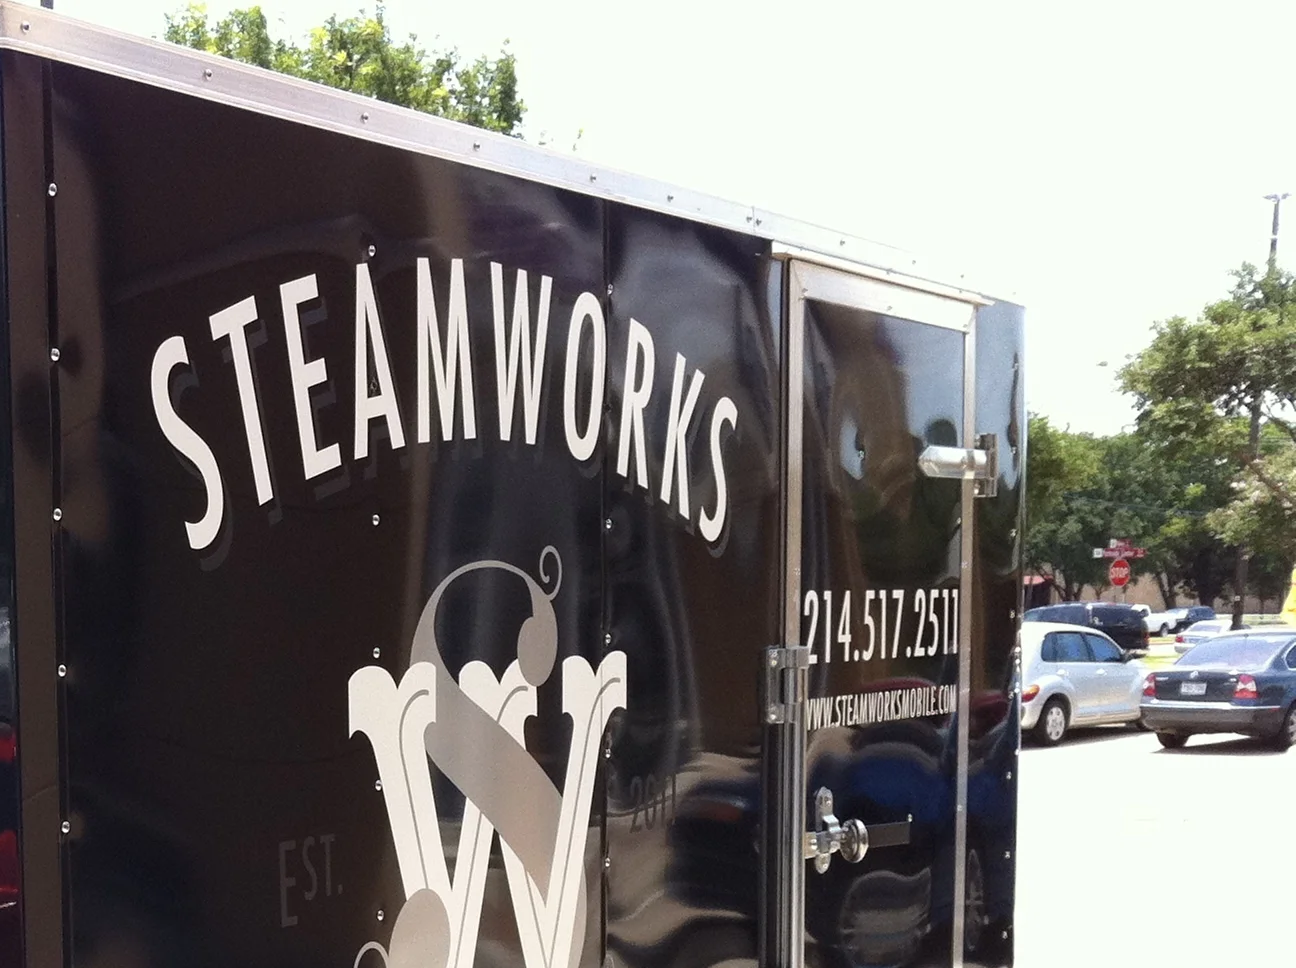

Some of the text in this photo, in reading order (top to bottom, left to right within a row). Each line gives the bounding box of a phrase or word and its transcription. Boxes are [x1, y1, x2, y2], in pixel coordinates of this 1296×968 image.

[151, 257, 738, 550] STEAMWORKS
[1110, 567, 1129, 579] STOP
[804, 588, 959, 665] 214.517.2511
[278, 833, 344, 928] EST.
